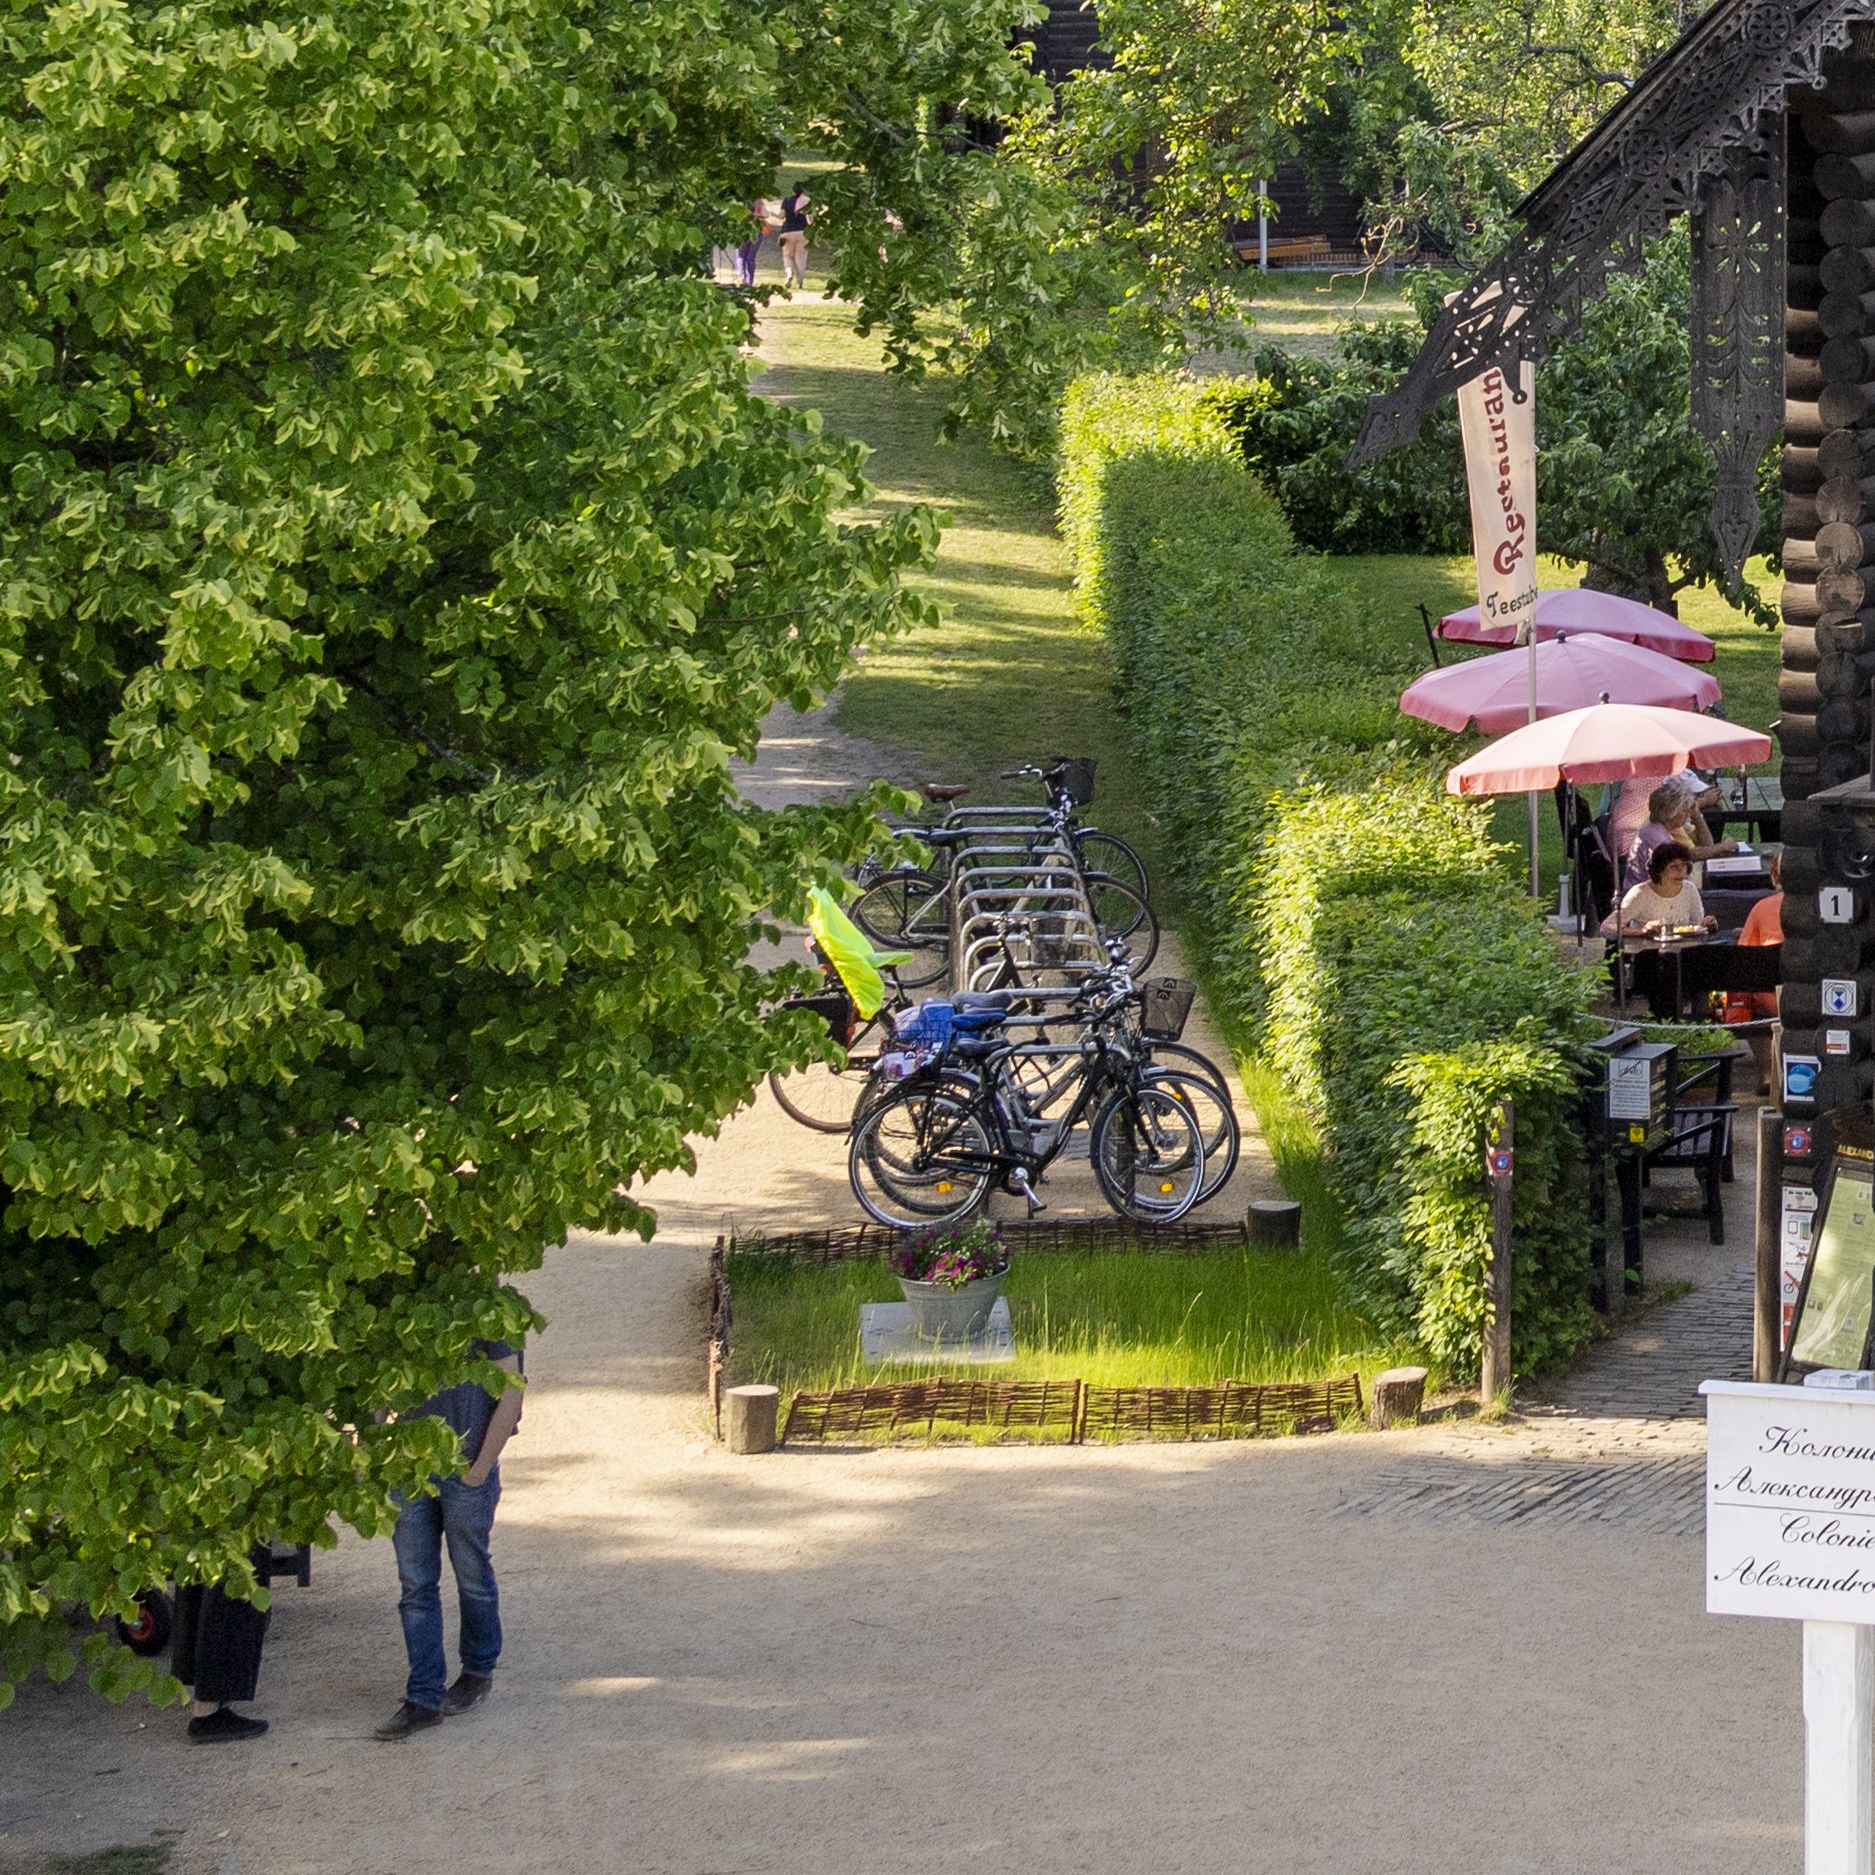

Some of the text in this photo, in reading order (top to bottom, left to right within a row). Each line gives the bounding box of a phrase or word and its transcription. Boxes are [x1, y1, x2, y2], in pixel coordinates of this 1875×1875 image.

[1482, 368, 1526, 576] Restauran
[1830, 894, 1841, 917] 1
[1836, 1143, 1875, 1161] ALEXAND
